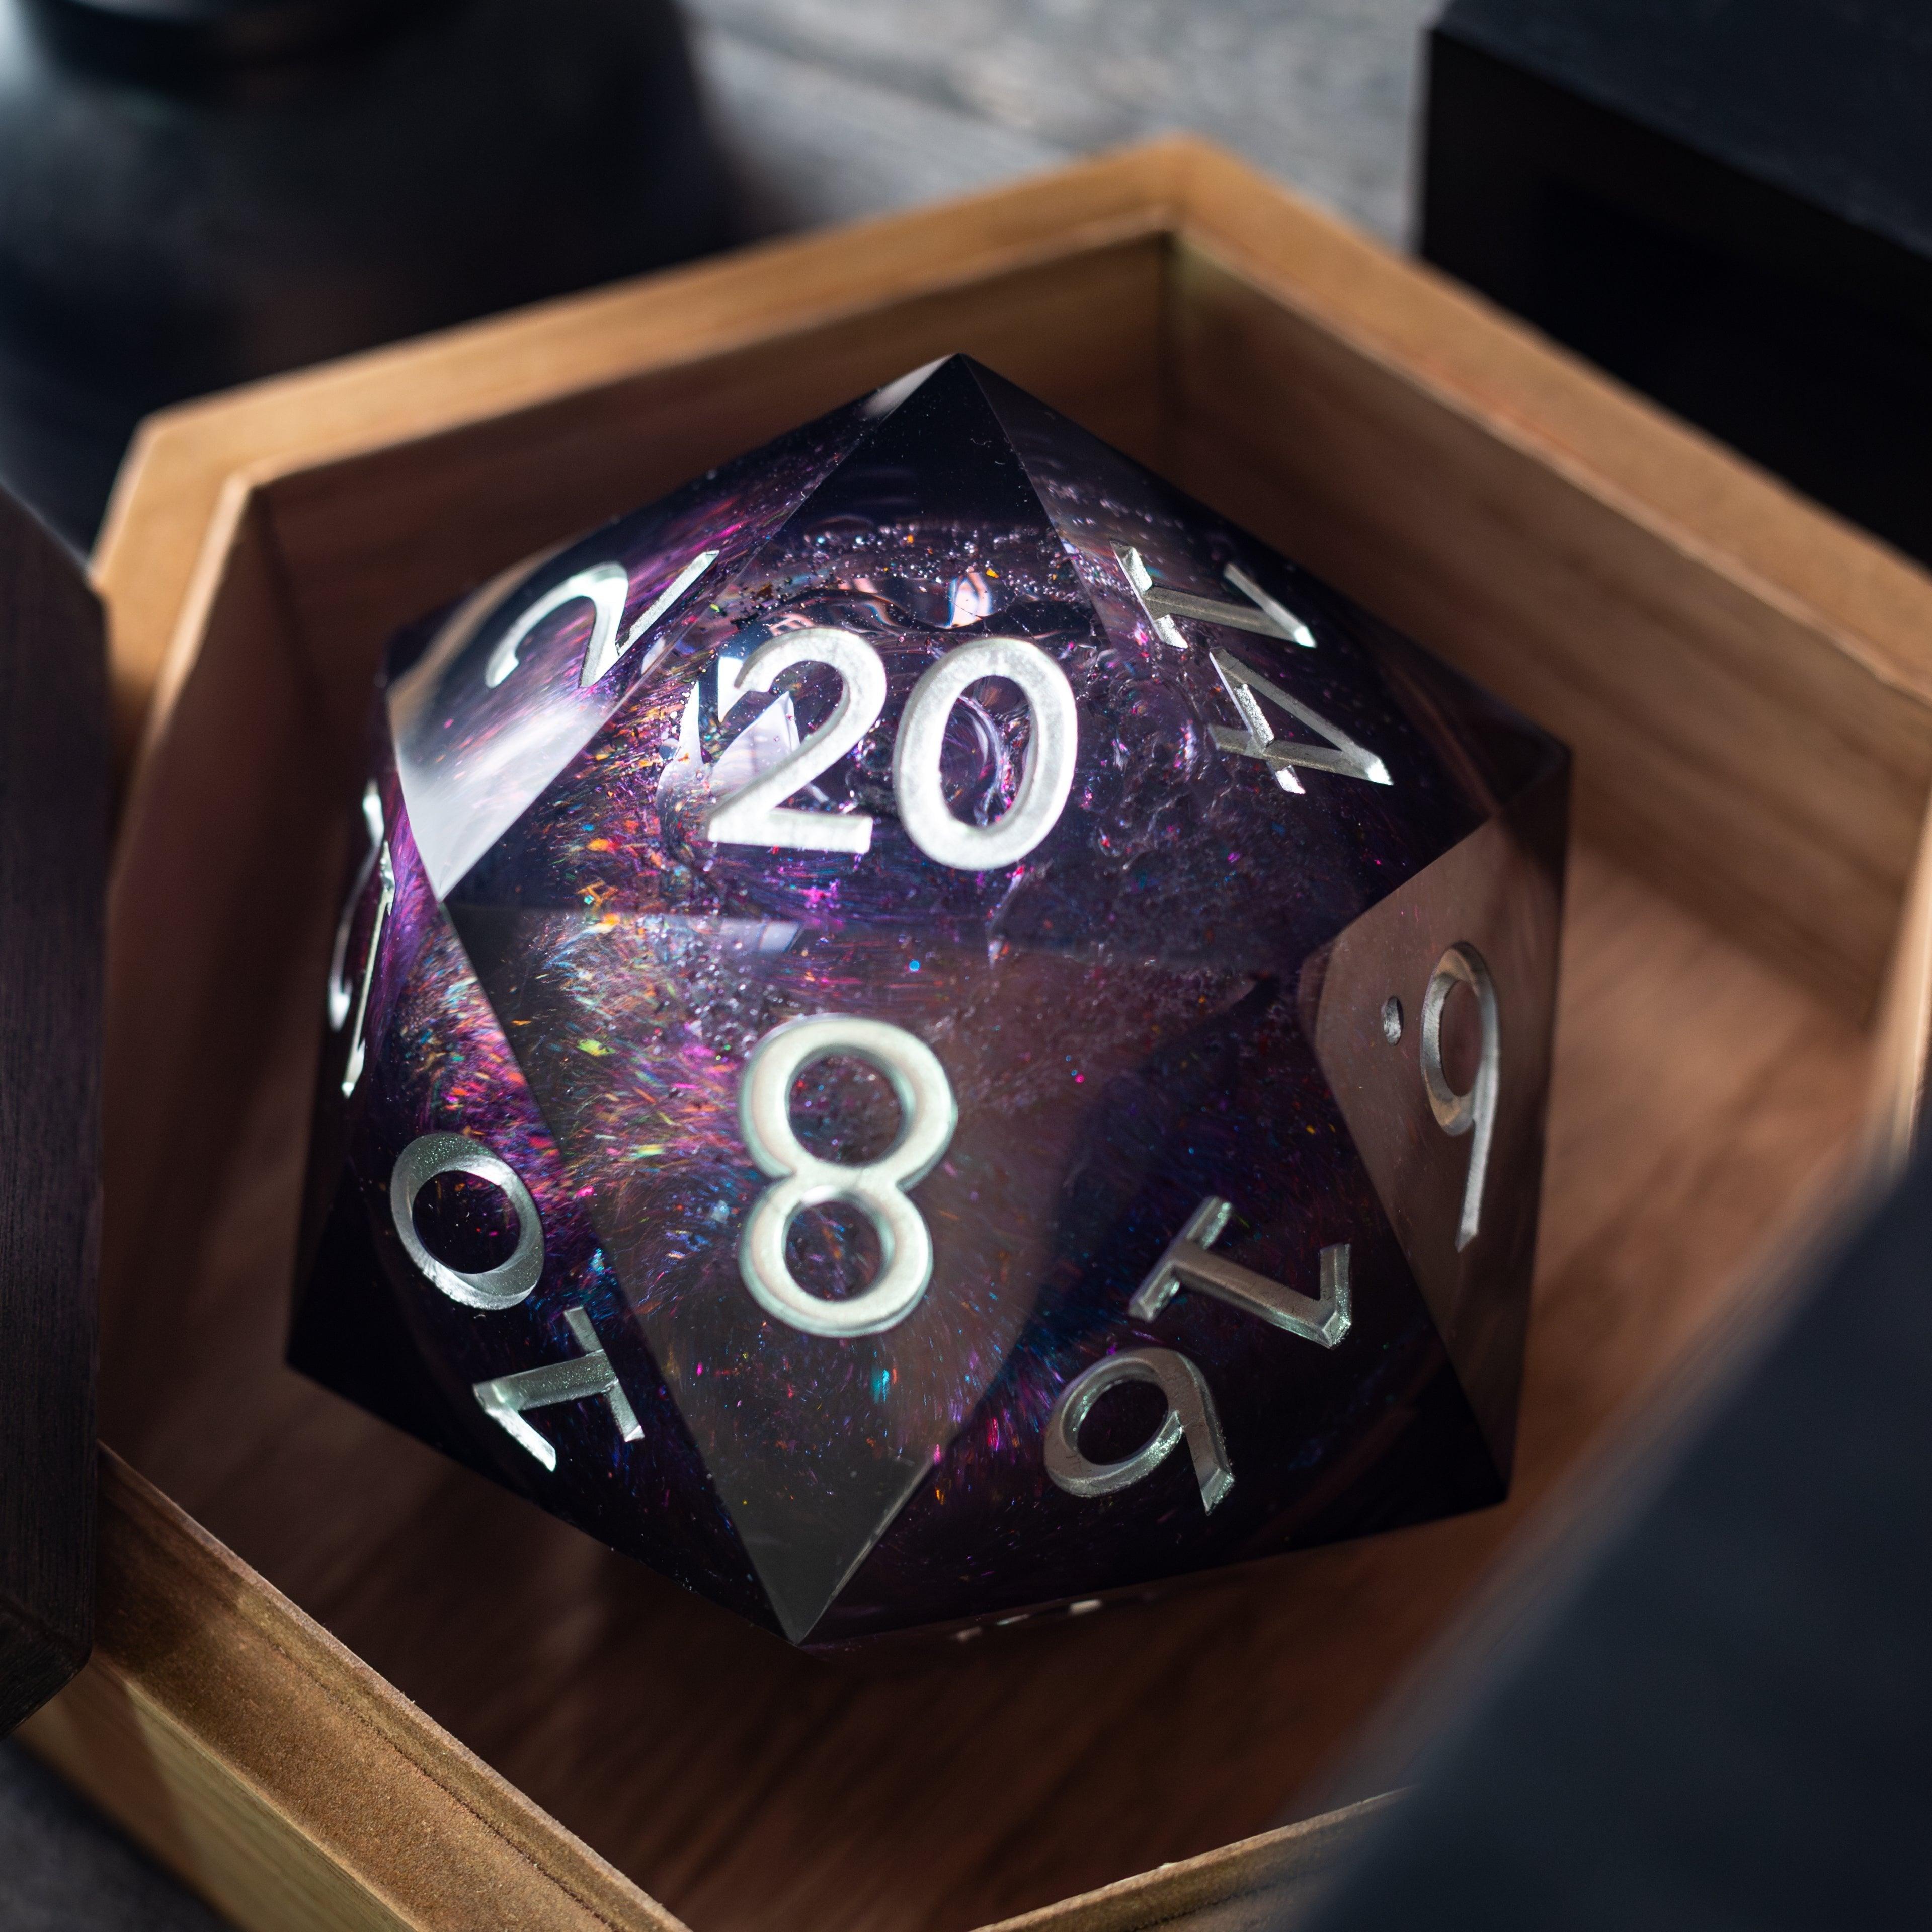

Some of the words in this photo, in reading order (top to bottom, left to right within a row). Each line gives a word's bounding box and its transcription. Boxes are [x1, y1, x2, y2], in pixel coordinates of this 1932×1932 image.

[486, 561, 719, 688] 2
[706, 627, 1078, 871] 20
[1110, 540, 1394, 795] 14
[390, 1132, 645, 1472] 10
[738, 1012, 958, 1338] 8
